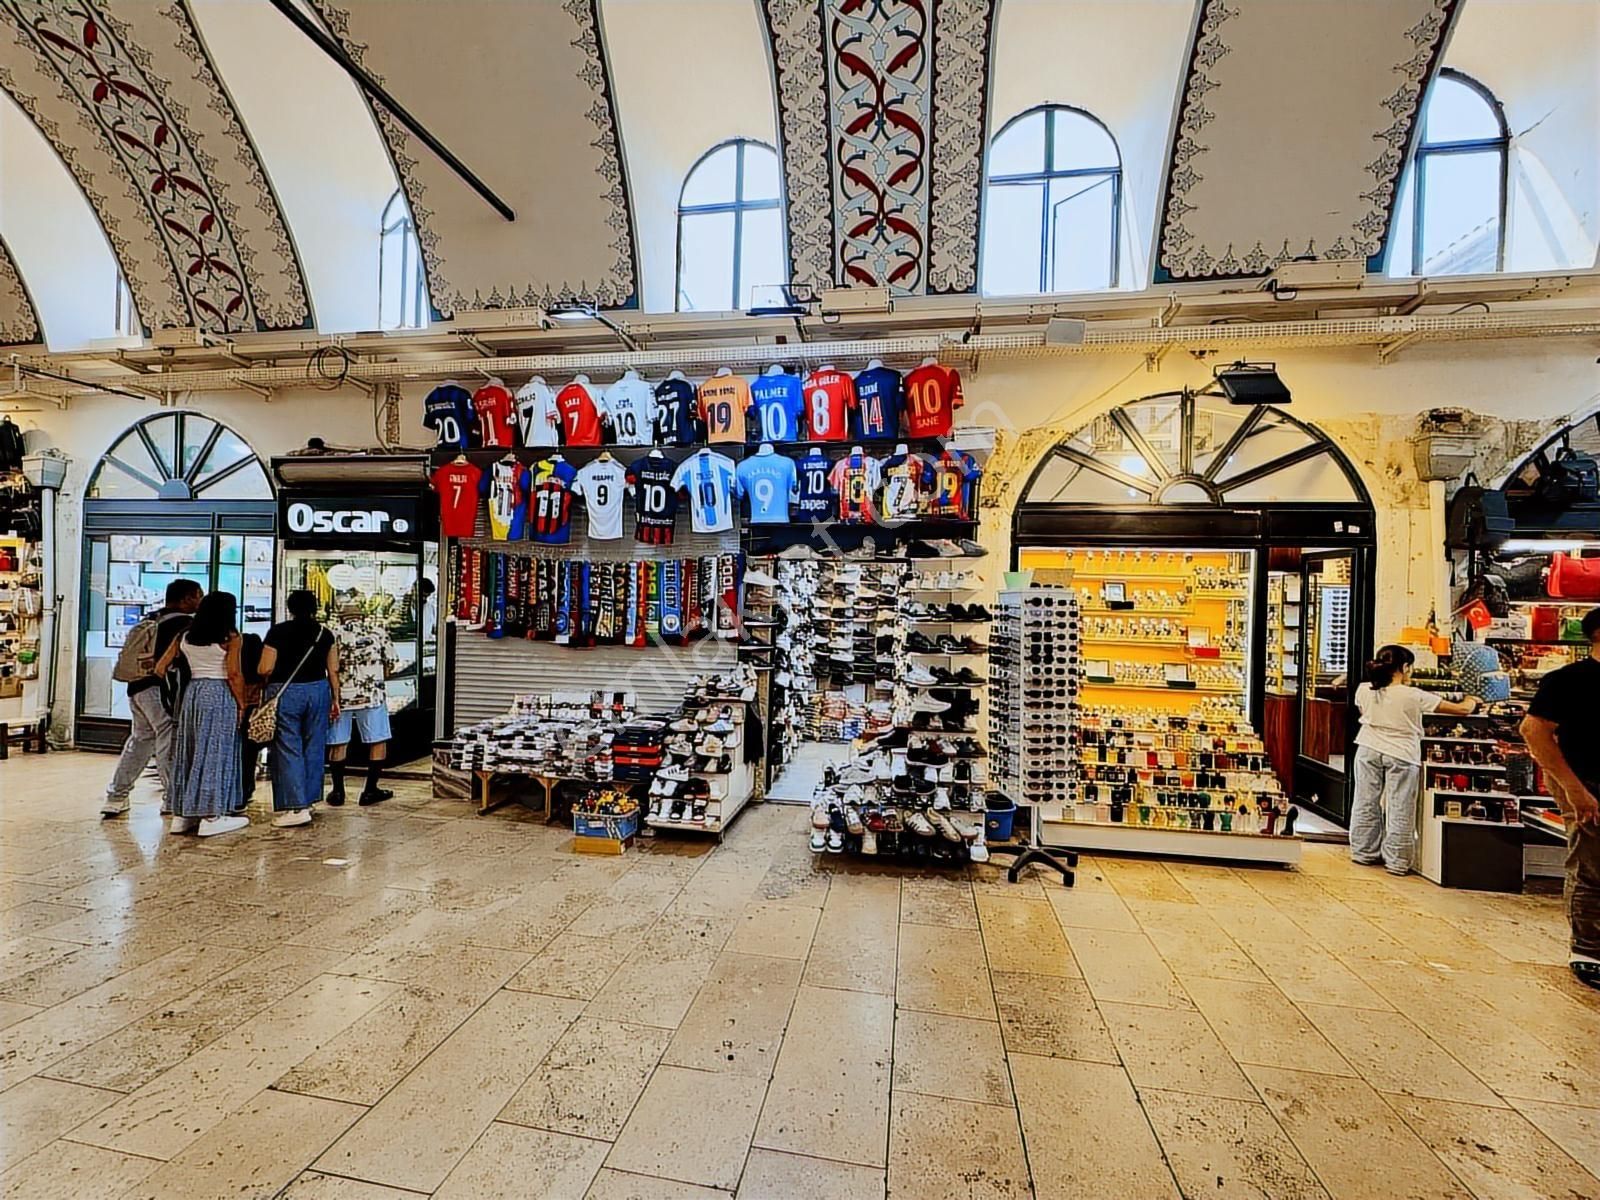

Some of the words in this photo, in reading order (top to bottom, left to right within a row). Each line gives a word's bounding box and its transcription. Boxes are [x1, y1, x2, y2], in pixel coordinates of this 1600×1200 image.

[754, 386, 788, 401] PALMER
[908, 379, 941, 417] 10
[568, 411, 579, 436] 7
[616, 412, 637, 438] 10
[707, 401, 731, 434] 19
[760, 402, 787, 442] 10
[811, 389, 830, 436] 8
[859, 396, 883, 435] 14
[434, 416, 460, 444] 20
[453, 485, 462, 509] 7
[597, 484, 609, 507] 9
[699, 482, 717, 508] 10
[754, 478, 774, 514] 9
[806, 470, 825, 495] 10
[643, 483, 666, 513] 10
[287, 503, 390, 533] Oscar
[720, 555, 734, 597] POOL
